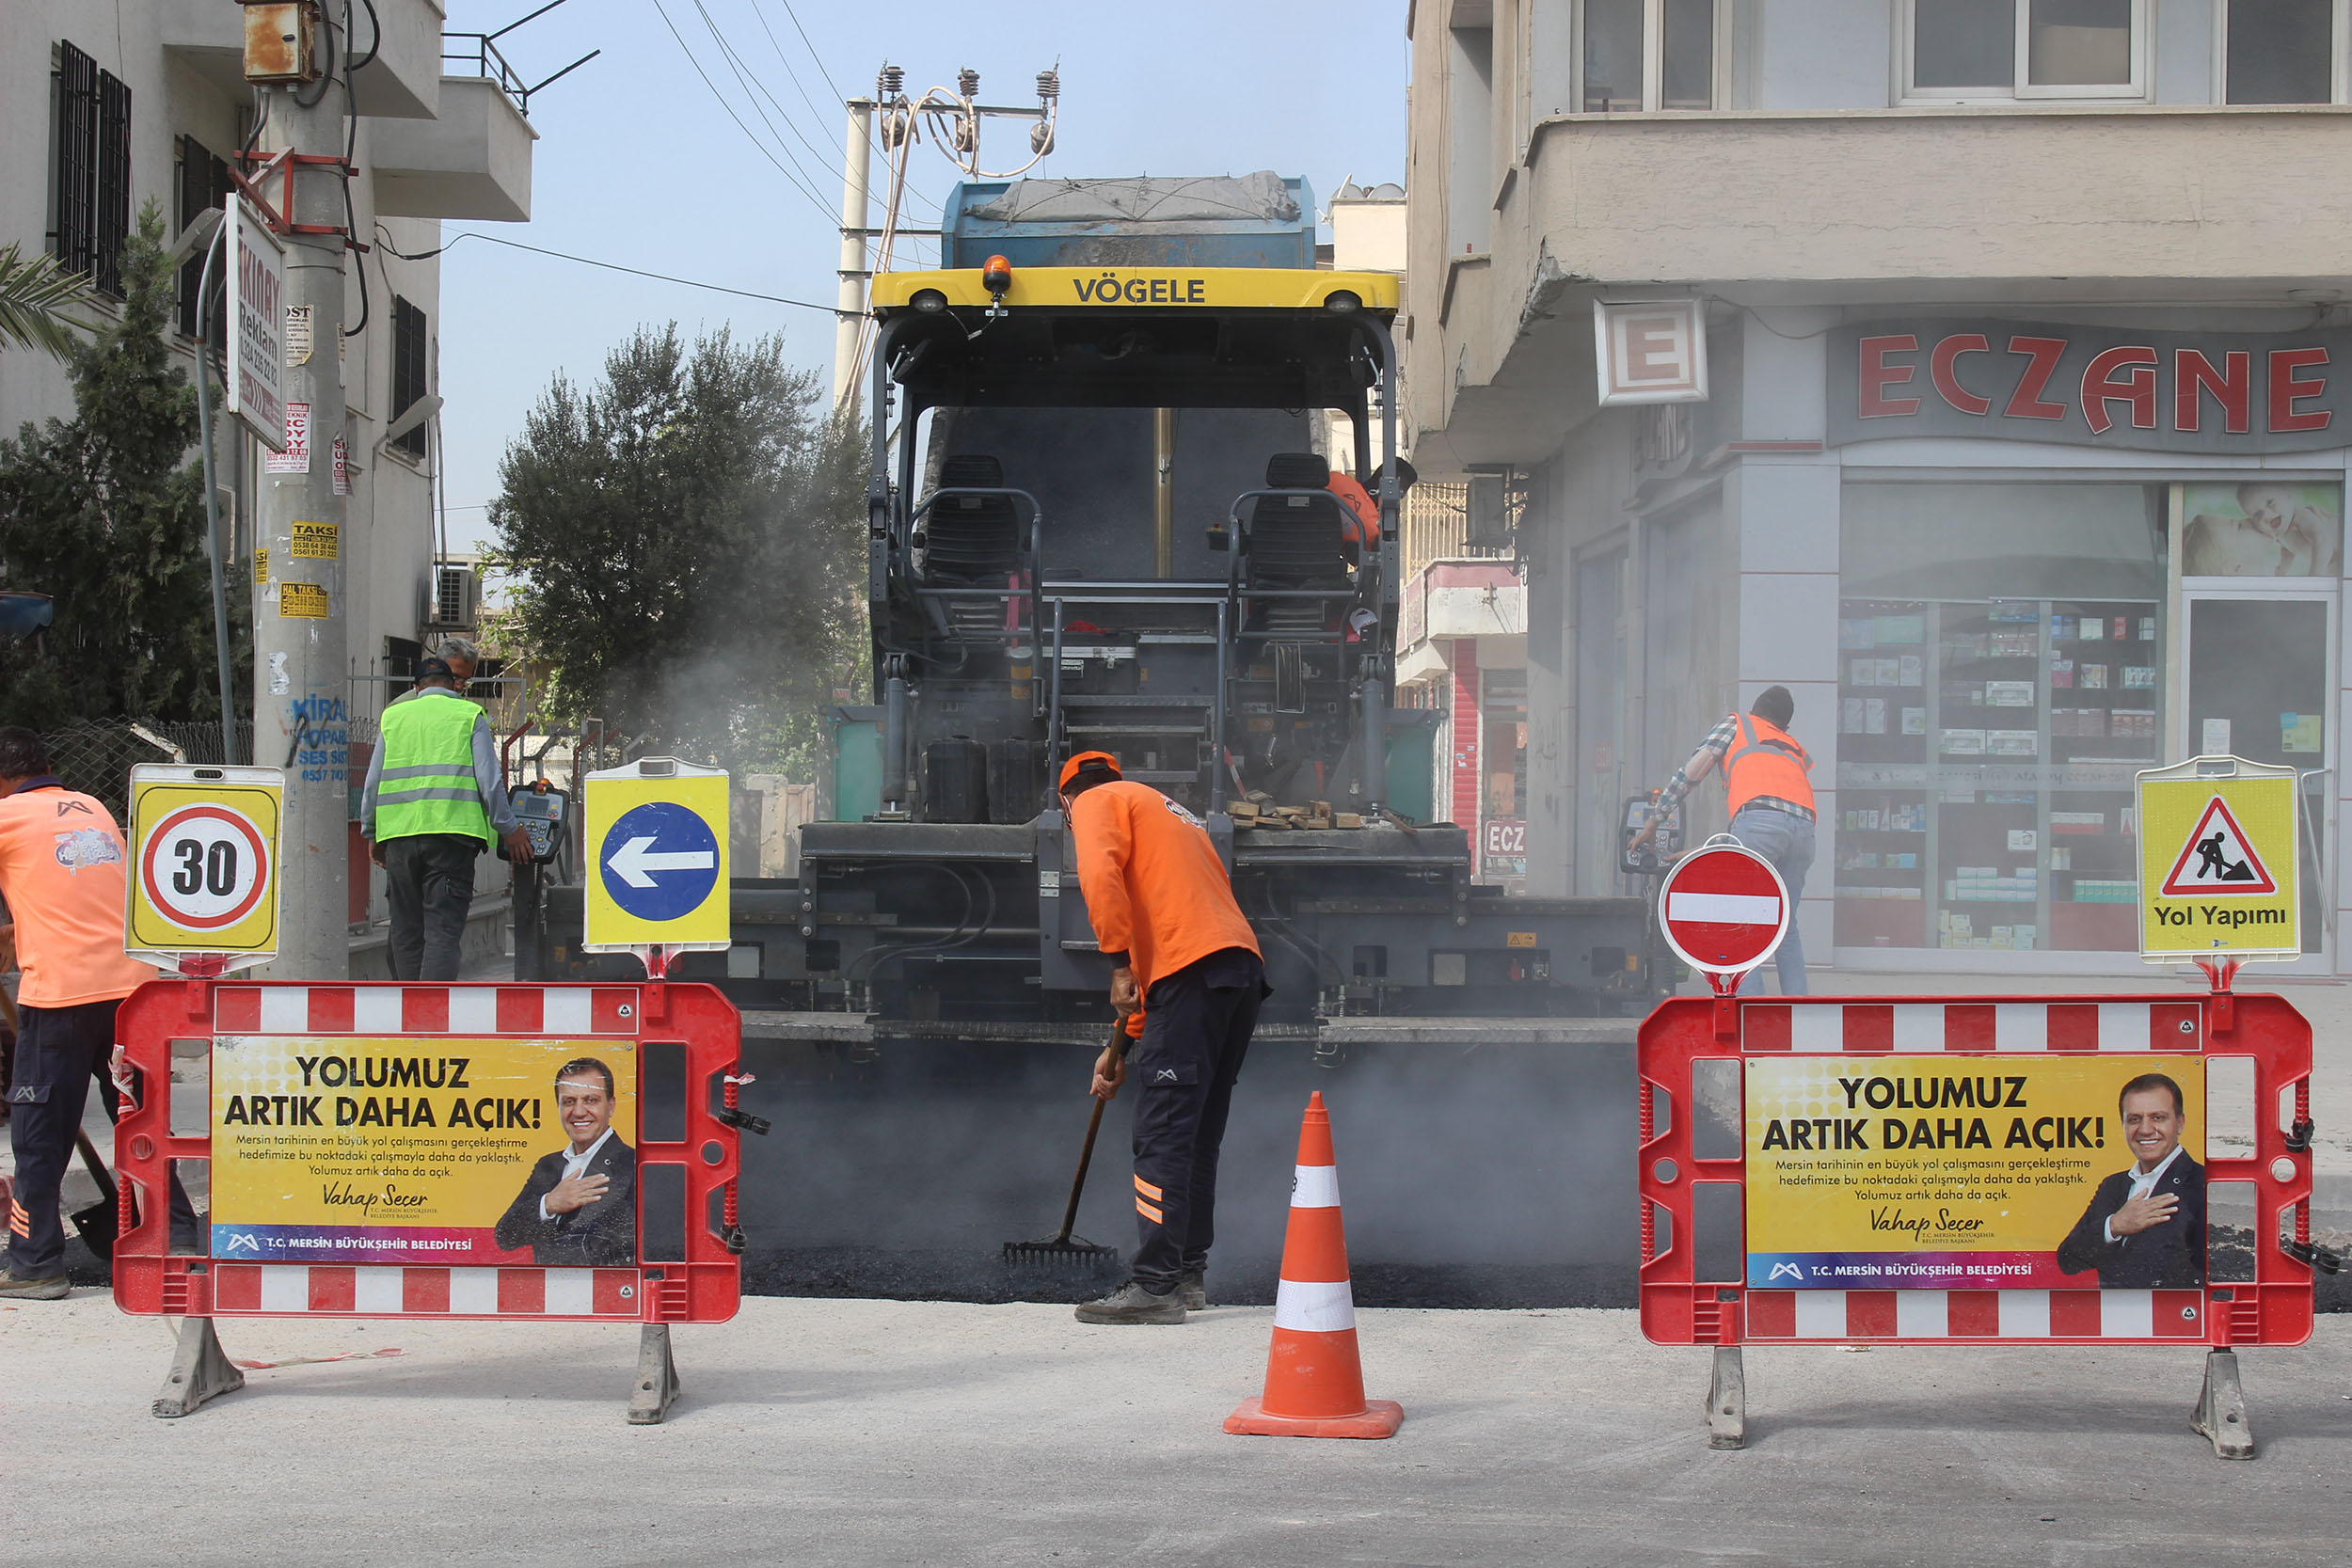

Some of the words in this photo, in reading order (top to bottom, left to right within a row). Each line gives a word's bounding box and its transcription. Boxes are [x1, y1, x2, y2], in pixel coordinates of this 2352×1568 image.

[1073, 272, 1205, 303] VÖGELE
[240, 301, 278, 362] Reklam
[1626, 318, 1680, 381] E
[1858, 333, 2332, 435] ECZANE
[294, 525, 338, 535] TAKSİ
[298, 750, 327, 765] SES
[1489, 826, 1524, 851] ECZ
[172, 839, 238, 896] 30
[2153, 906, 2192, 926] Yol
[2201, 906, 2286, 929] Yapımı
[295, 1055, 470, 1088] YOLUMUZ
[1837, 1076, 2027, 1109] YOLUMUZ
[224, 1095, 324, 1126] ARTIK
[336, 1096, 437, 1128] DAHA
[447, 1098, 541, 1132] AÇIK!
[236, 1134, 271, 1145] Mersin
[274, 1134, 318, 1145] tarihinin
[337, 1135, 369, 1148] büyük
[372, 1136, 388, 1147] yol
[390, 1136, 448, 1148] çalışmasını
[451, 1137, 528, 1149] gerçekleştirme
[1761, 1118, 1869, 1150] ARTIK
[1883, 1117, 1993, 1149] DAHA
[2003, 1117, 2105, 1152] AÇIK!
[239, 1149, 295, 1160] hedefimize
[299, 1150, 312, 1160] bu
[316, 1150, 367, 1161] noktadaki
[371, 1150, 425, 1164] çalışmayla
[428, 1152, 455, 1162] daha
[458, 1152, 472, 1163] da
[475, 1153, 524, 1164] yaklaştık.
[1775, 1160, 1813, 1170] Mersin
[1817, 1159, 1864, 1169] tarihinin
[1885, 1159, 1919, 1171] büyük
[1923, 1159, 1939, 1170] yol
[1943, 1159, 2005, 1170] çalışmasını
[2008, 1158, 2091, 1170] gerçekleştirme
[309, 1165, 352, 1175] Yolumuz
[356, 1165, 379, 1176] artık
[382, 1166, 409, 1176] daha
[412, 1166, 426, 1177] da
[429, 1167, 453, 1179] açık.
[1779, 1175, 1840, 1185] hedefimize
[1844, 1175, 1858, 1184] bu
[1862, 1174, 1918, 1184] noktadaki
[1921, 1174, 1980, 1186] çalışmayla
[1984, 1174, 2012, 1183] daha
[2016, 1174, 2031, 1183] da
[2034, 1173, 2087, 1185] yaklaştık.
[323, 1180, 378, 1216] Vahap
[382, 1183, 428, 1207] Seçer
[1854, 1190, 1901, 1199] Yolumuz
[1905, 1190, 1931, 1199] artık
[1934, 1189, 1963, 1199] daha
[1966, 1189, 1981, 1199] da
[1985, 1189, 2010, 1201] açık.
[1870, 1206, 1931, 1242] Vahap
[1935, 1208, 1984, 1231] Seçer
[266, 1237, 286, 1248] T.C.
[289, 1235, 332, 1248] MERSİN
[336, 1236, 408, 1251] BÜYÜKŞEHİR
[411, 1238, 472, 1250] BELEDİYESİ
[1811, 1266, 1832, 1275] T.C.
[1835, 1263, 1882, 1275] MERSİN
[1885, 1262, 1963, 1277] BÜYÜKŞEHİR
[1966, 1262, 2032, 1275] BELEDİYESİ
